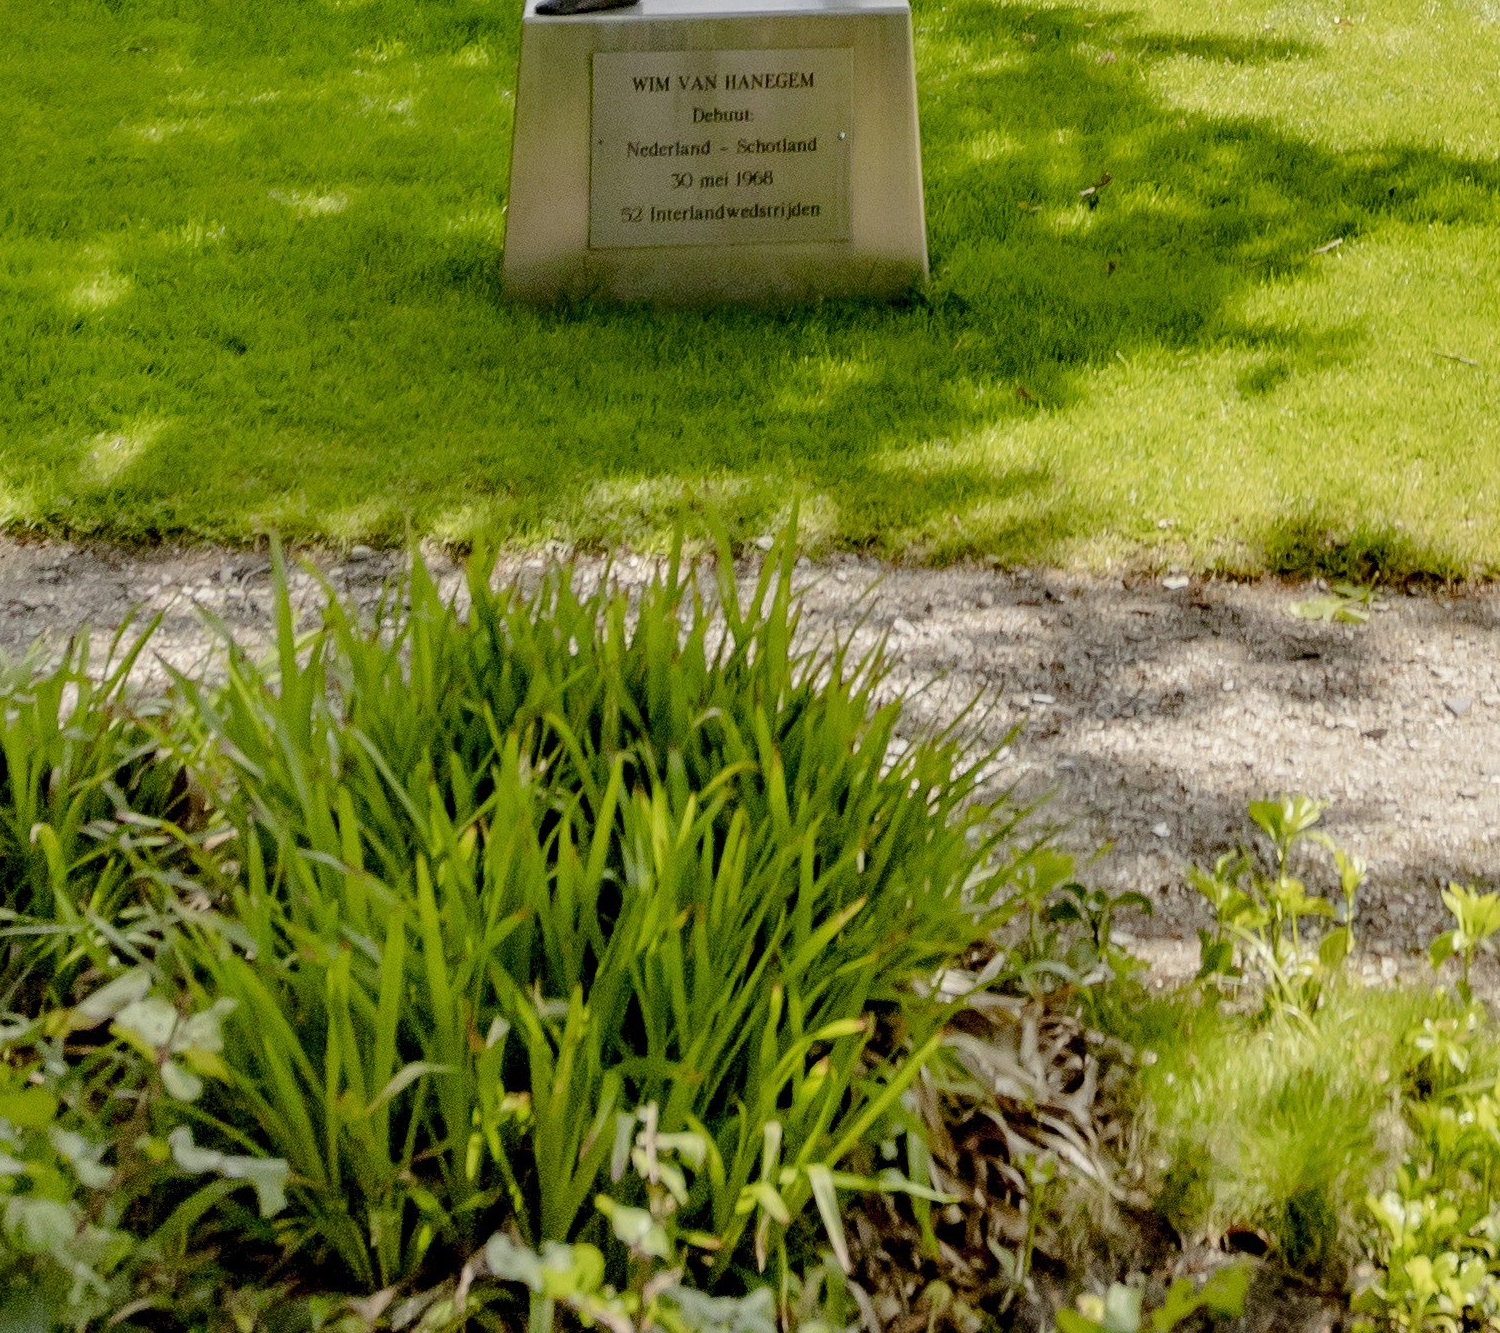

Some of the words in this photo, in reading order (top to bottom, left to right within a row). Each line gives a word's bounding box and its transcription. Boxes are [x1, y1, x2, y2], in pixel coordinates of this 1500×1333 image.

[631, 76, 670, 92] WIM
[678, 74, 717, 91] VAN
[725, 72, 815, 90] HANEGEM
[627, 140, 711, 158] Nederland
[736, 137, 817, 155] Schotland
[671, 171, 693, 189] 30
[700, 171, 729, 188] mei
[736, 170, 774, 187] 1968
[650, 203, 821, 222] Interlandwedstrijden
